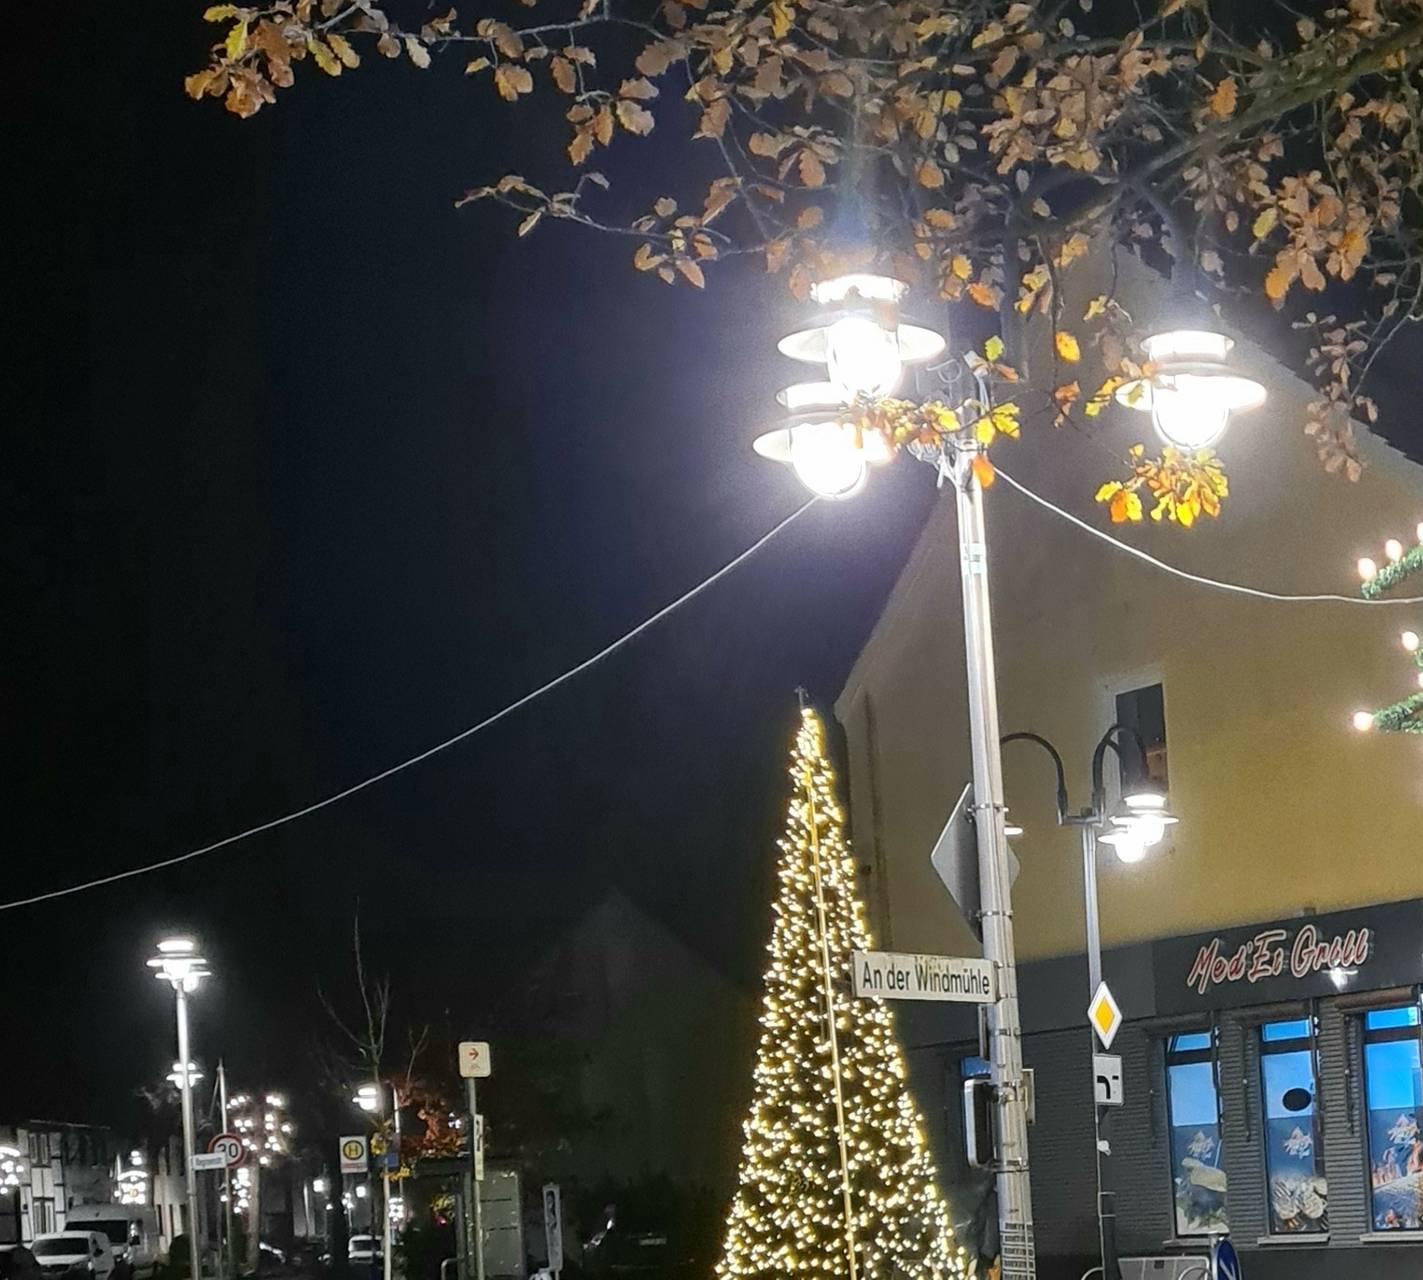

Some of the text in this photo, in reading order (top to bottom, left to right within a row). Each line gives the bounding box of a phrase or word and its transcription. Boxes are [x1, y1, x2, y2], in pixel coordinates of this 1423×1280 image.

[1290, 924, 1370, 978] Grill
[862, 961, 990, 995] An der Windmühle
